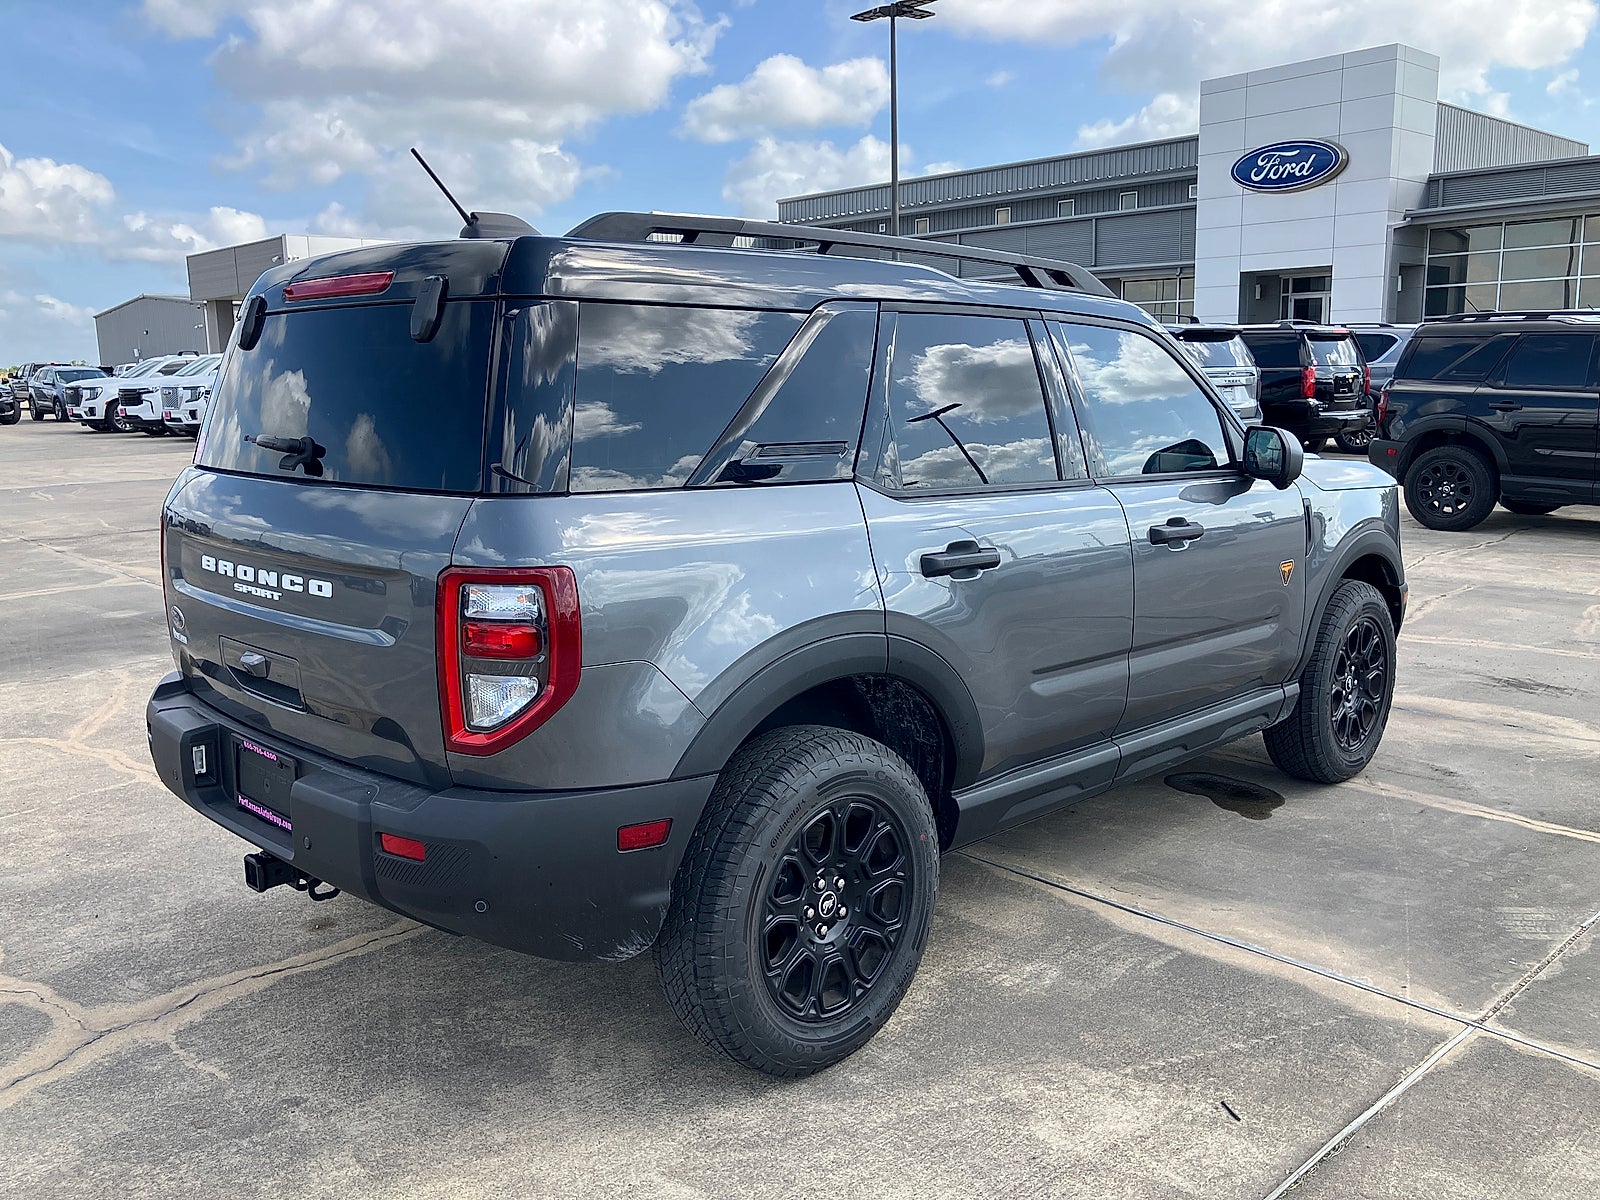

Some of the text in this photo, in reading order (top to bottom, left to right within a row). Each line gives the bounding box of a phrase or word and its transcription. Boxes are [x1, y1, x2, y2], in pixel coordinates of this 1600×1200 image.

[1251, 149, 1316, 181] Ford
[202, 555, 333, 598] BRONCO
[233, 582, 282, 600] SPORT
[770, 802, 802, 849] Continental
